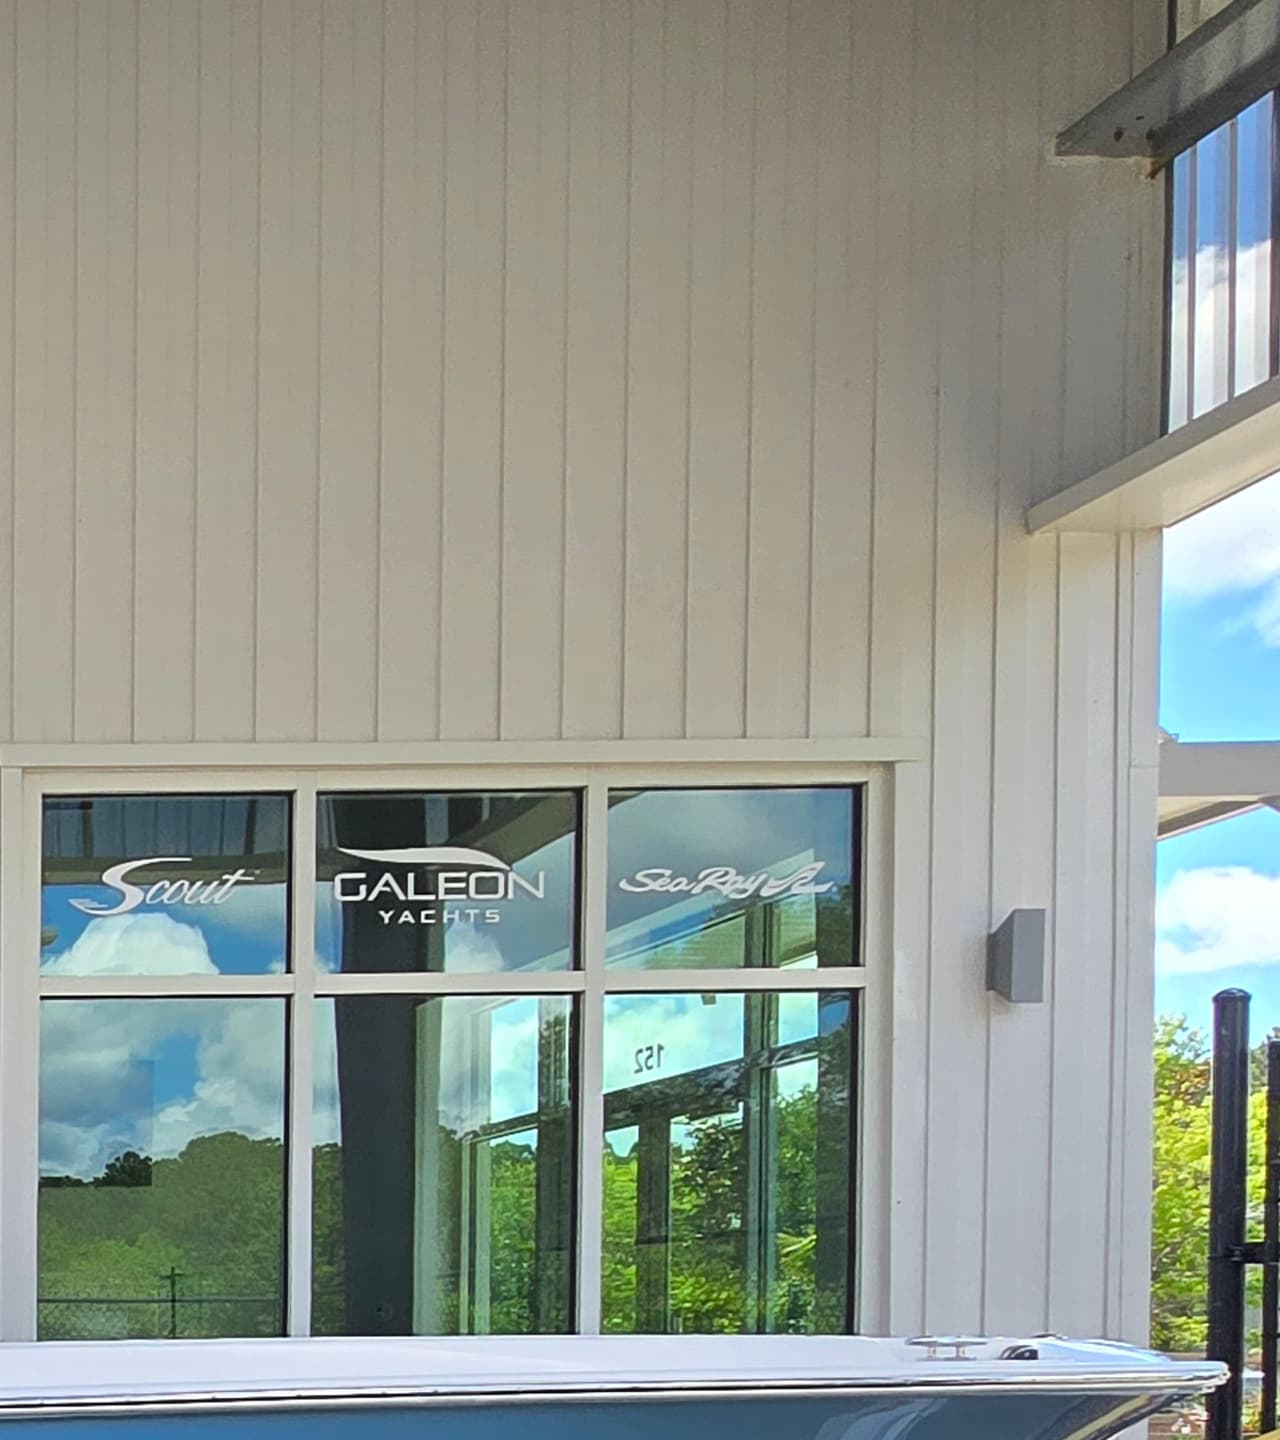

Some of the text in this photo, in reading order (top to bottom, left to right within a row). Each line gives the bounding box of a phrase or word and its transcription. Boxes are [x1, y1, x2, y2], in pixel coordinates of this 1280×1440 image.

[68, 857, 255, 915] Scout
[333, 871, 545, 901] GALEON
[618, 866, 768, 899] Sea Ray
[378, 909, 501, 924] YACHTS
